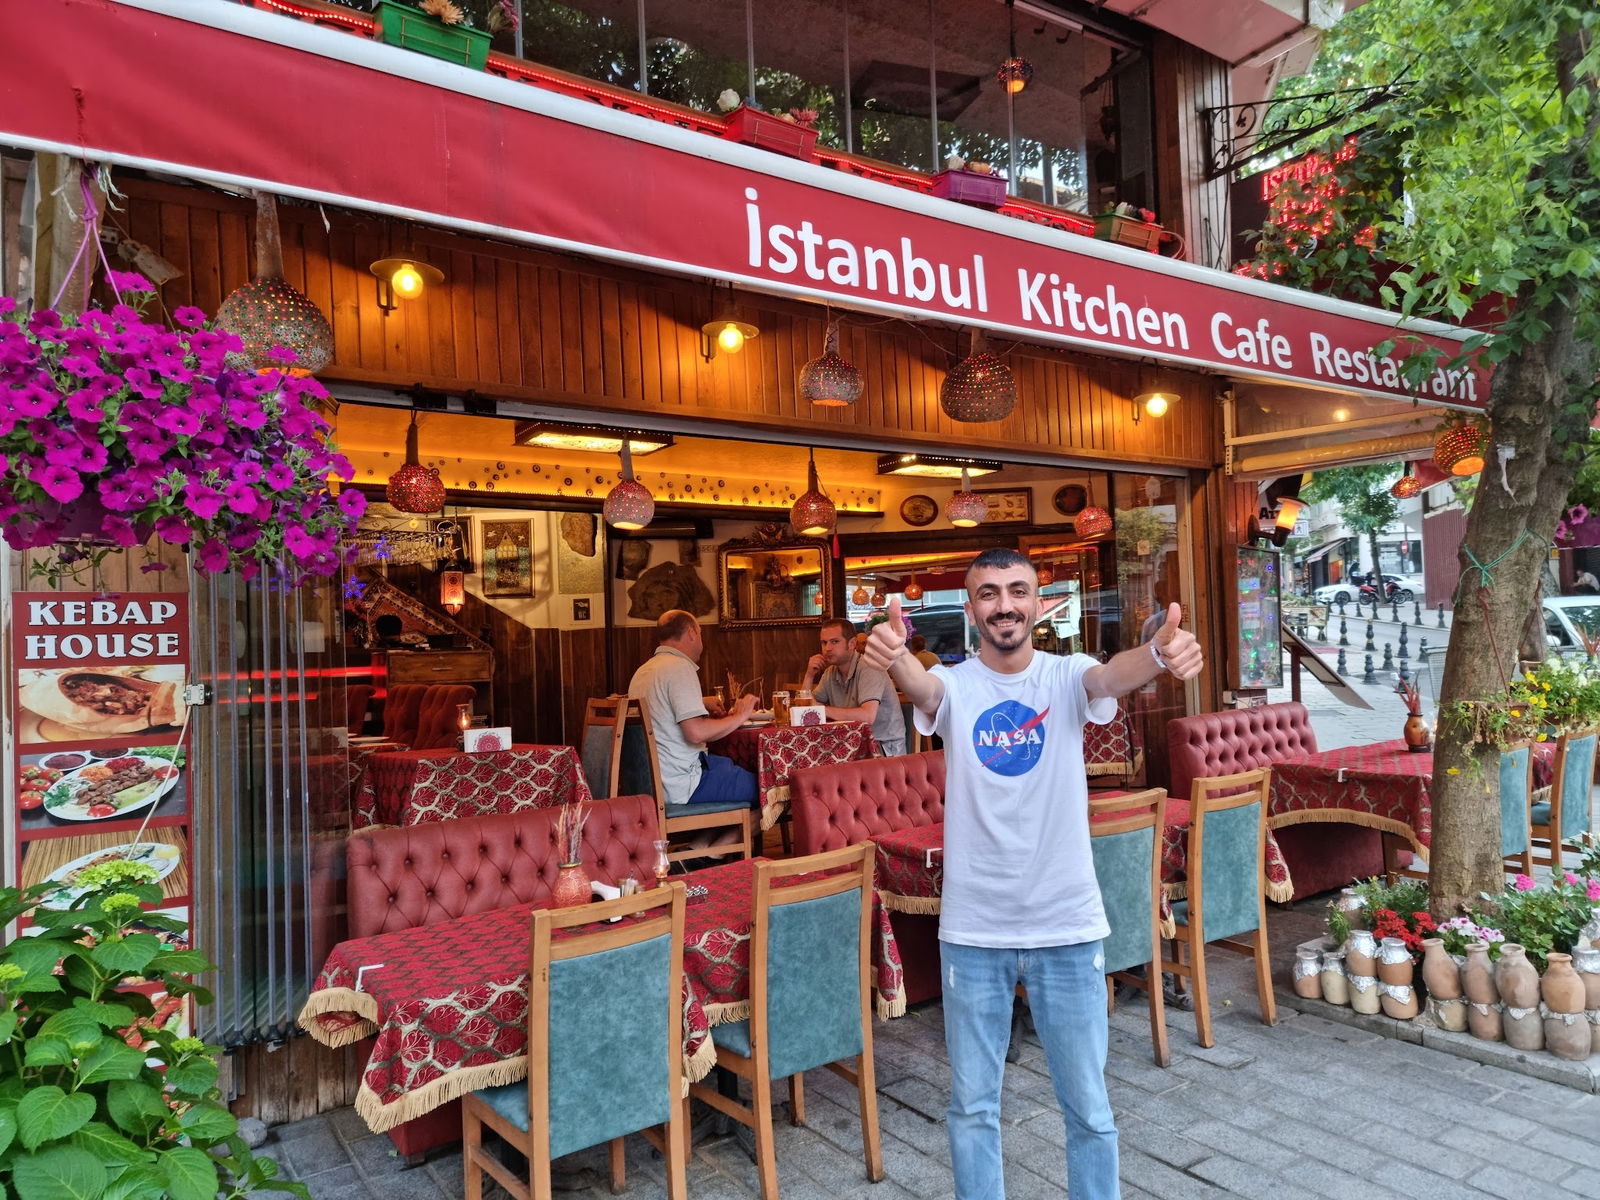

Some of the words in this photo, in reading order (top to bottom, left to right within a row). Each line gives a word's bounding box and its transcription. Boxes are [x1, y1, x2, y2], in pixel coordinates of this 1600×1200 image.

[745, 187, 988, 312] İstanbul
[1018, 268, 1190, 350] Kitchen
[1210, 312, 1293, 370] Cafe
[28, 601, 177, 626] KEBAP
[25, 633, 179, 660] HOUSE
[978, 728, 1042, 747] NASA
